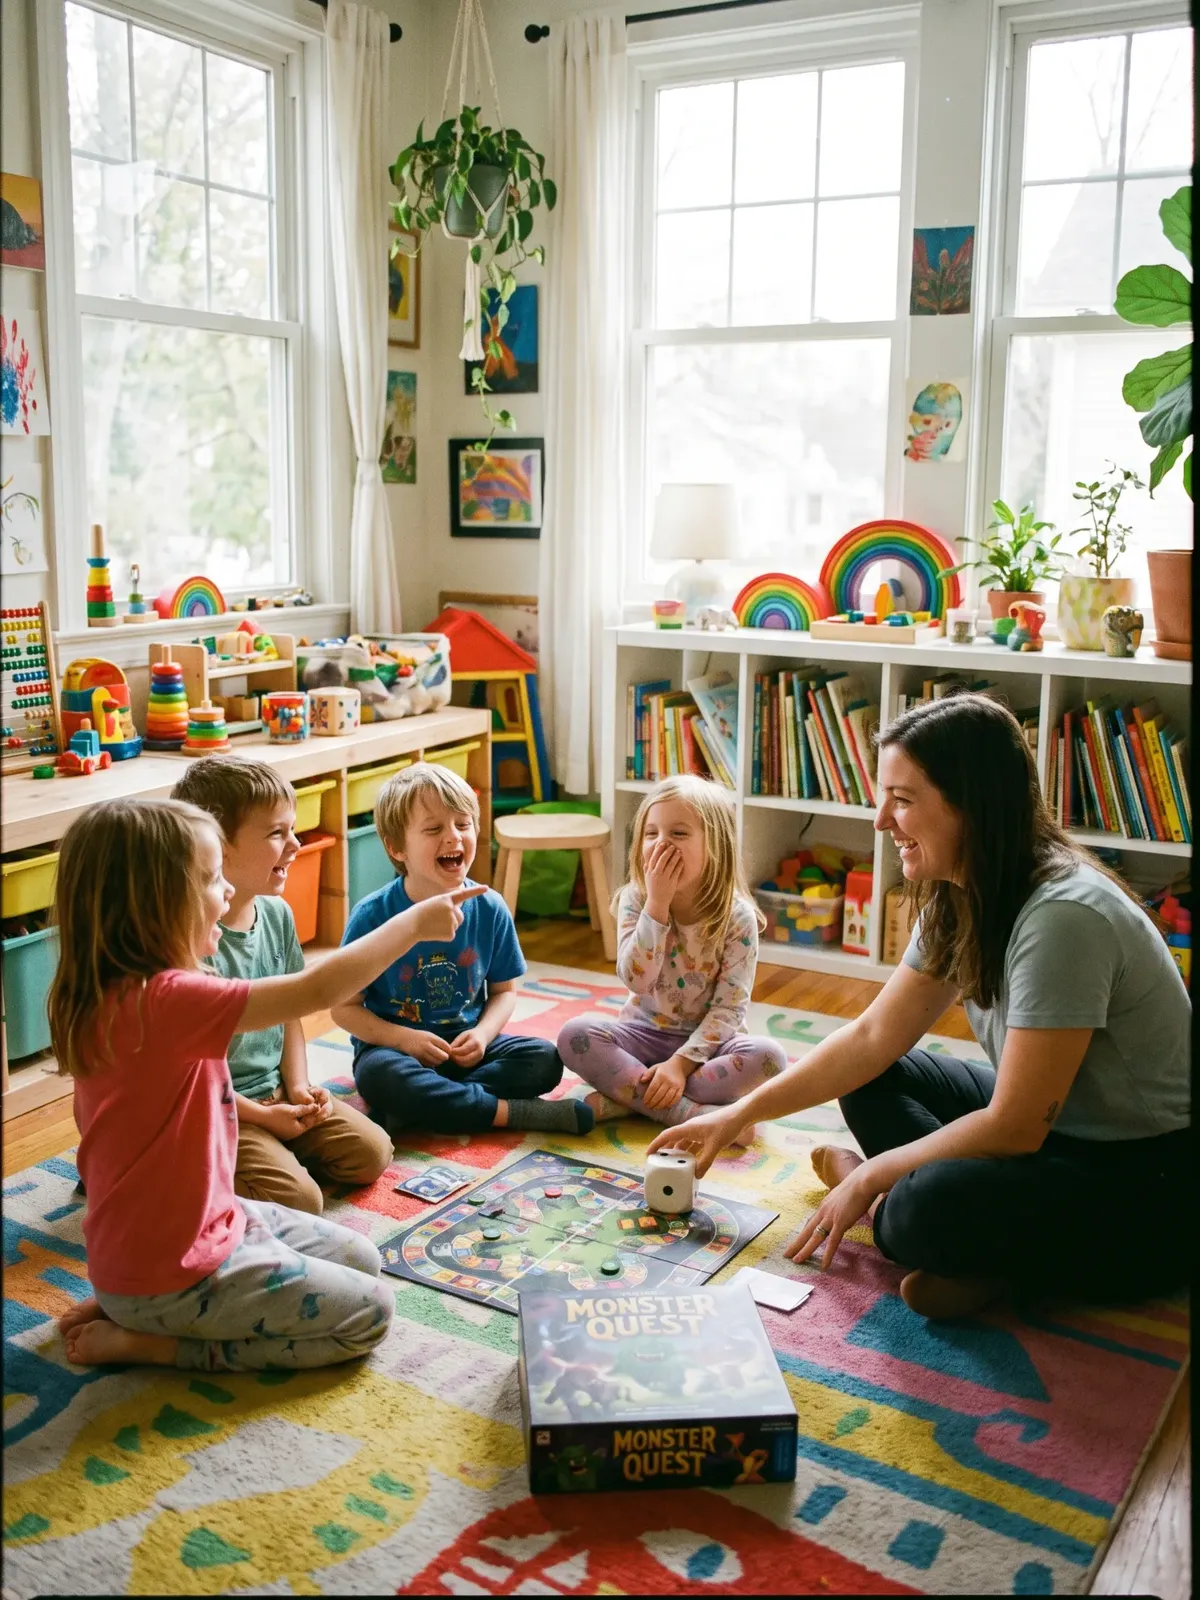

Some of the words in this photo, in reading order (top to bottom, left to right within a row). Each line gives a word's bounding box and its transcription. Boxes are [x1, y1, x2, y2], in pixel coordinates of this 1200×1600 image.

[565, 1294, 719, 1322] MONSTER
[586, 1315, 703, 1340] QUEST
[614, 1427, 716, 1456] MONSTER
[623, 1451, 705, 1481] QUEST
